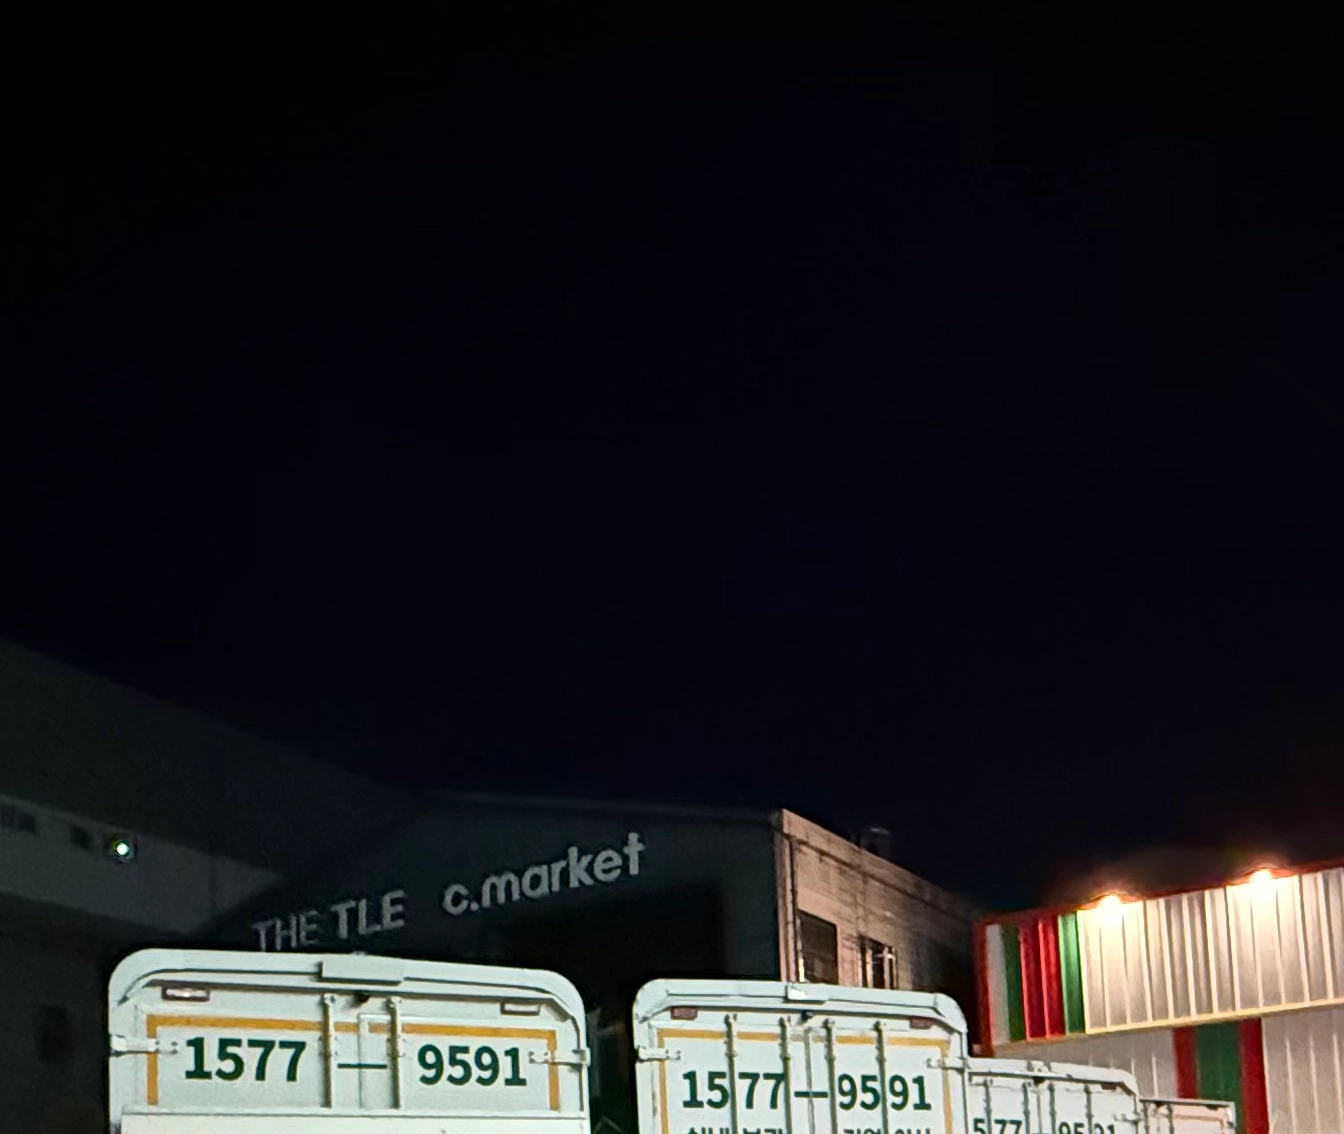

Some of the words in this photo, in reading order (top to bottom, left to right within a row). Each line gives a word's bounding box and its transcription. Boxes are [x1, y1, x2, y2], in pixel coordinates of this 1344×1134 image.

[442, 832, 646, 916] c.market
[253, 910, 320, 952] THE
[330, 889, 407, 939] TLE
